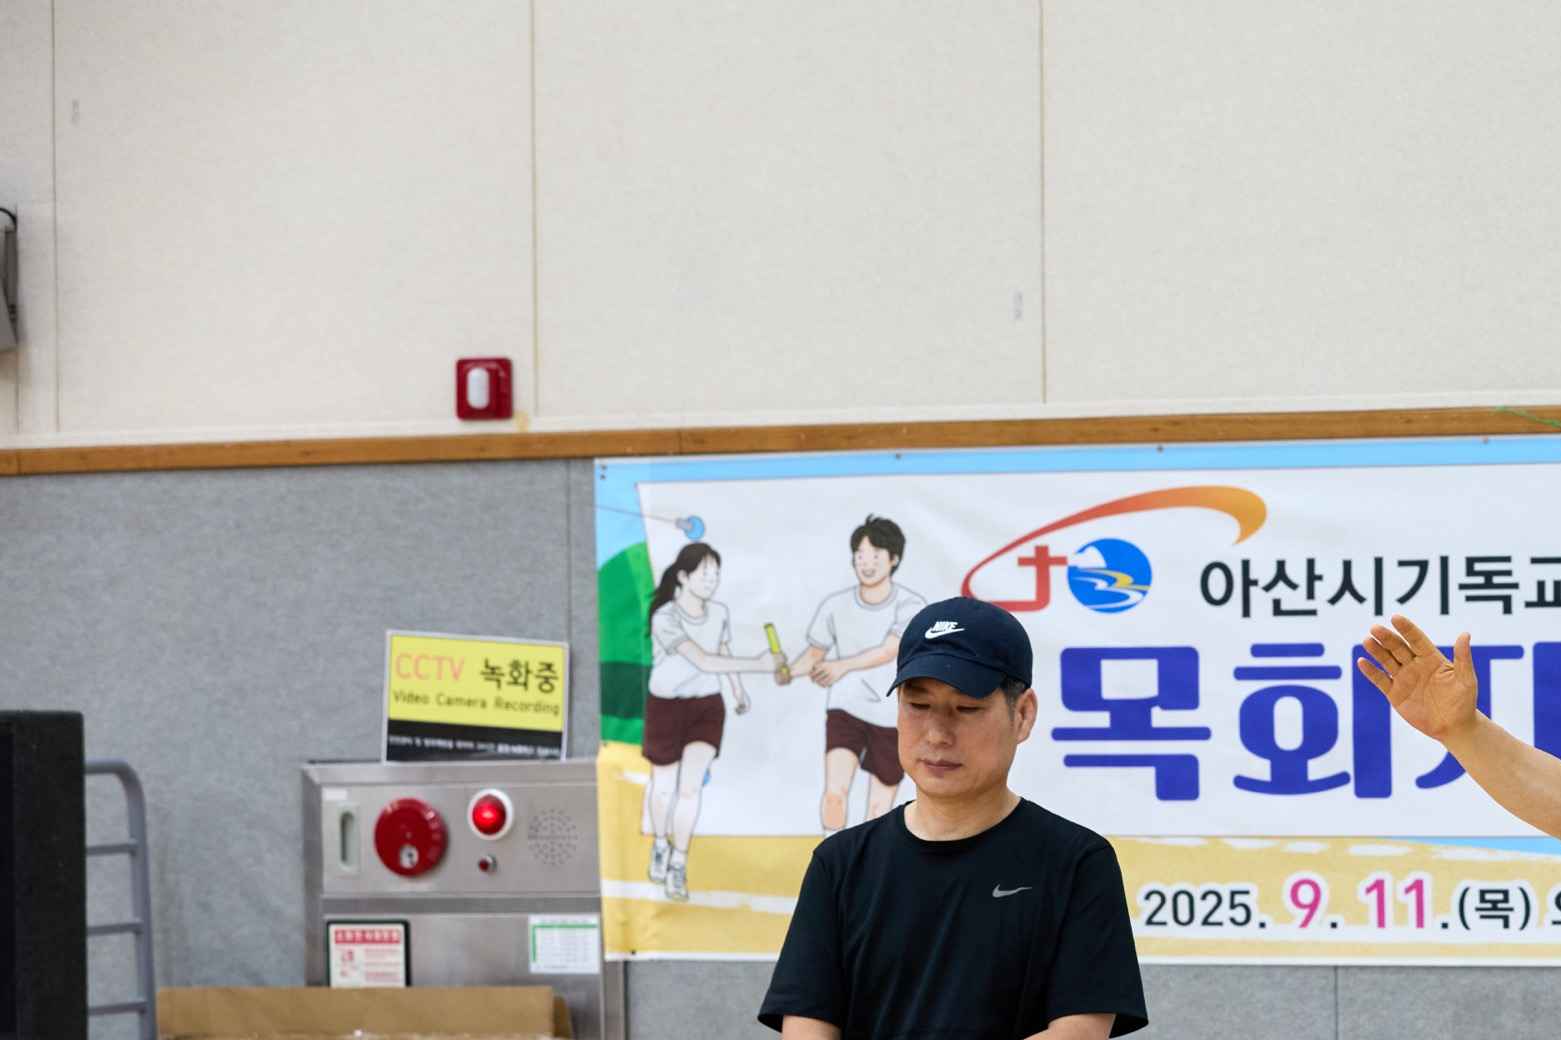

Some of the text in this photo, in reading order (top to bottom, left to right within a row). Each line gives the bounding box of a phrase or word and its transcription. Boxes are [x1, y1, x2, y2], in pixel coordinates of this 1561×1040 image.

[395, 653, 559, 694] CCTV 녹화중
[393, 690, 561, 716] Video Camera Recording
[1145, 890, 1267, 929] 2025.
